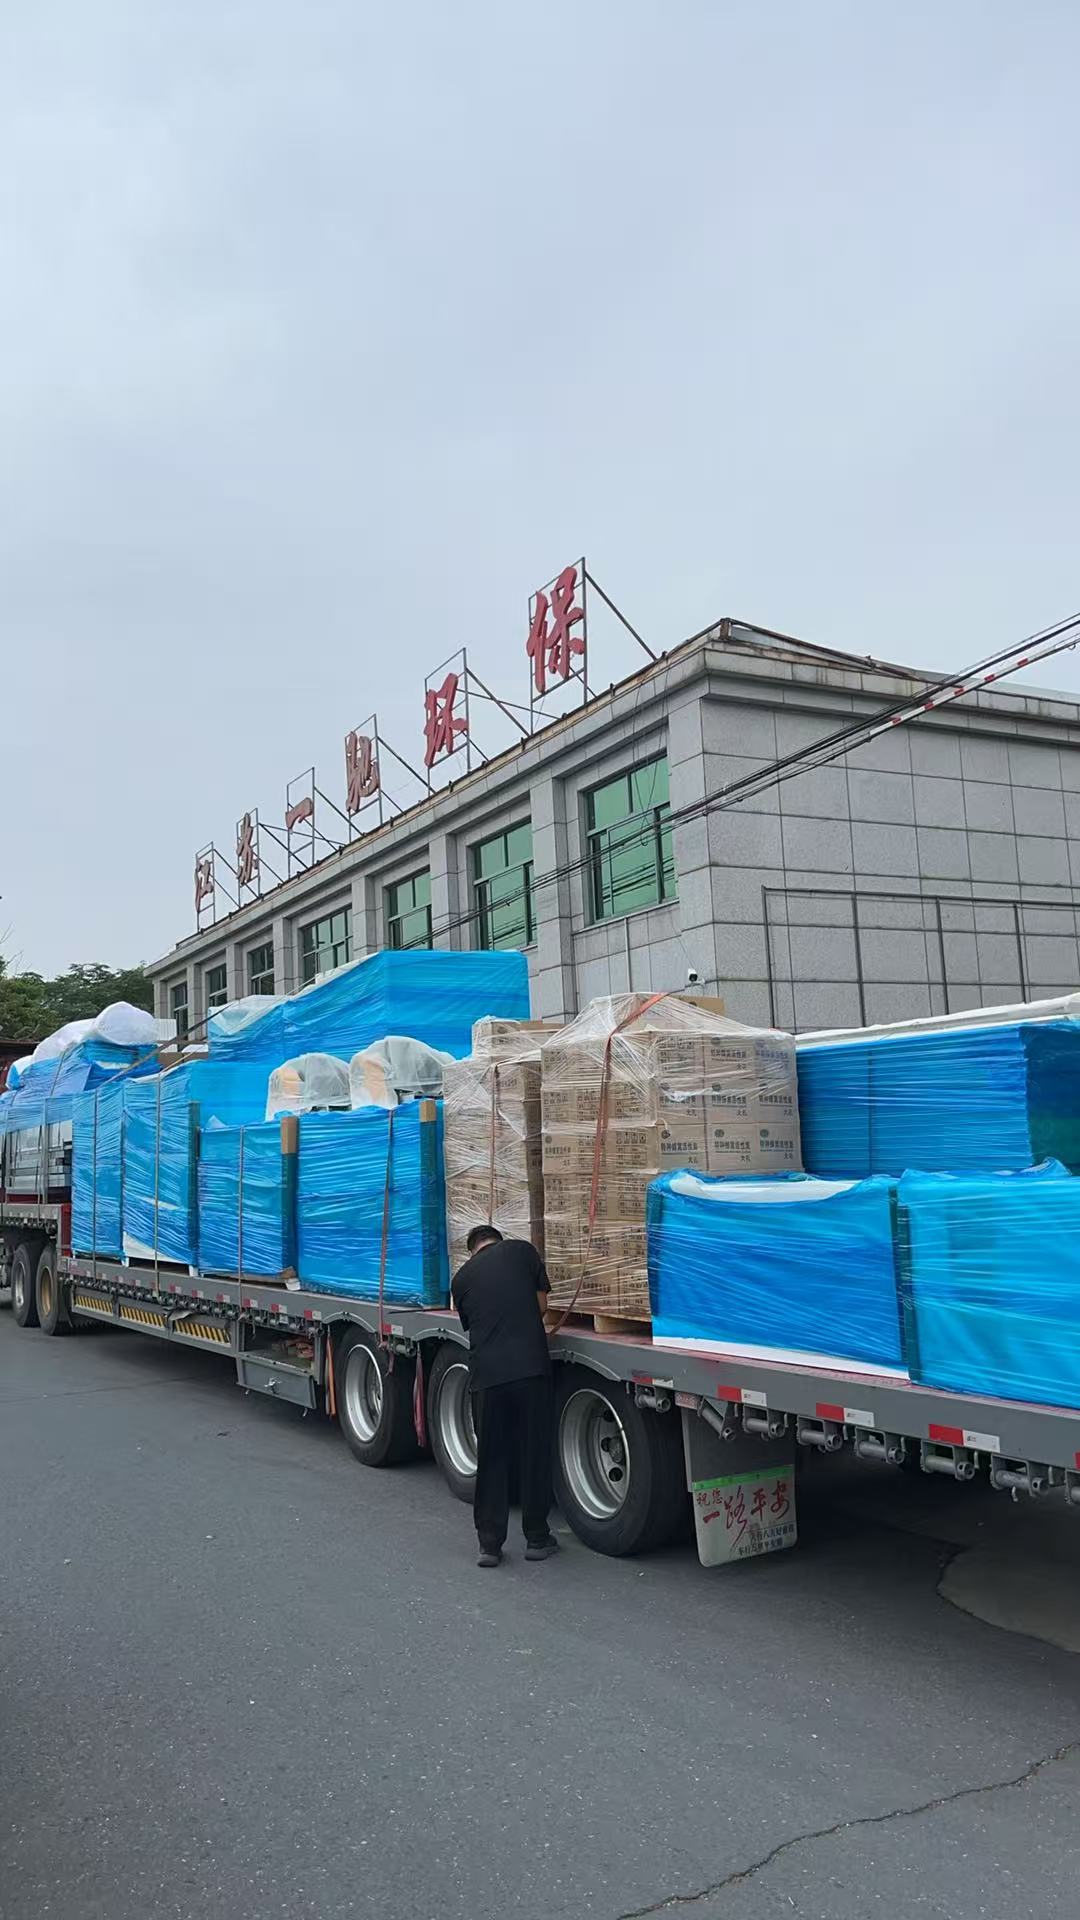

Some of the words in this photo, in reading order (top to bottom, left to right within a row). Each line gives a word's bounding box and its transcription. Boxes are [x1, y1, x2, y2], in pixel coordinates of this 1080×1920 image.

[696, 1488, 723, 1506] 祝您
[703, 1480, 790, 1552] 一路平安
